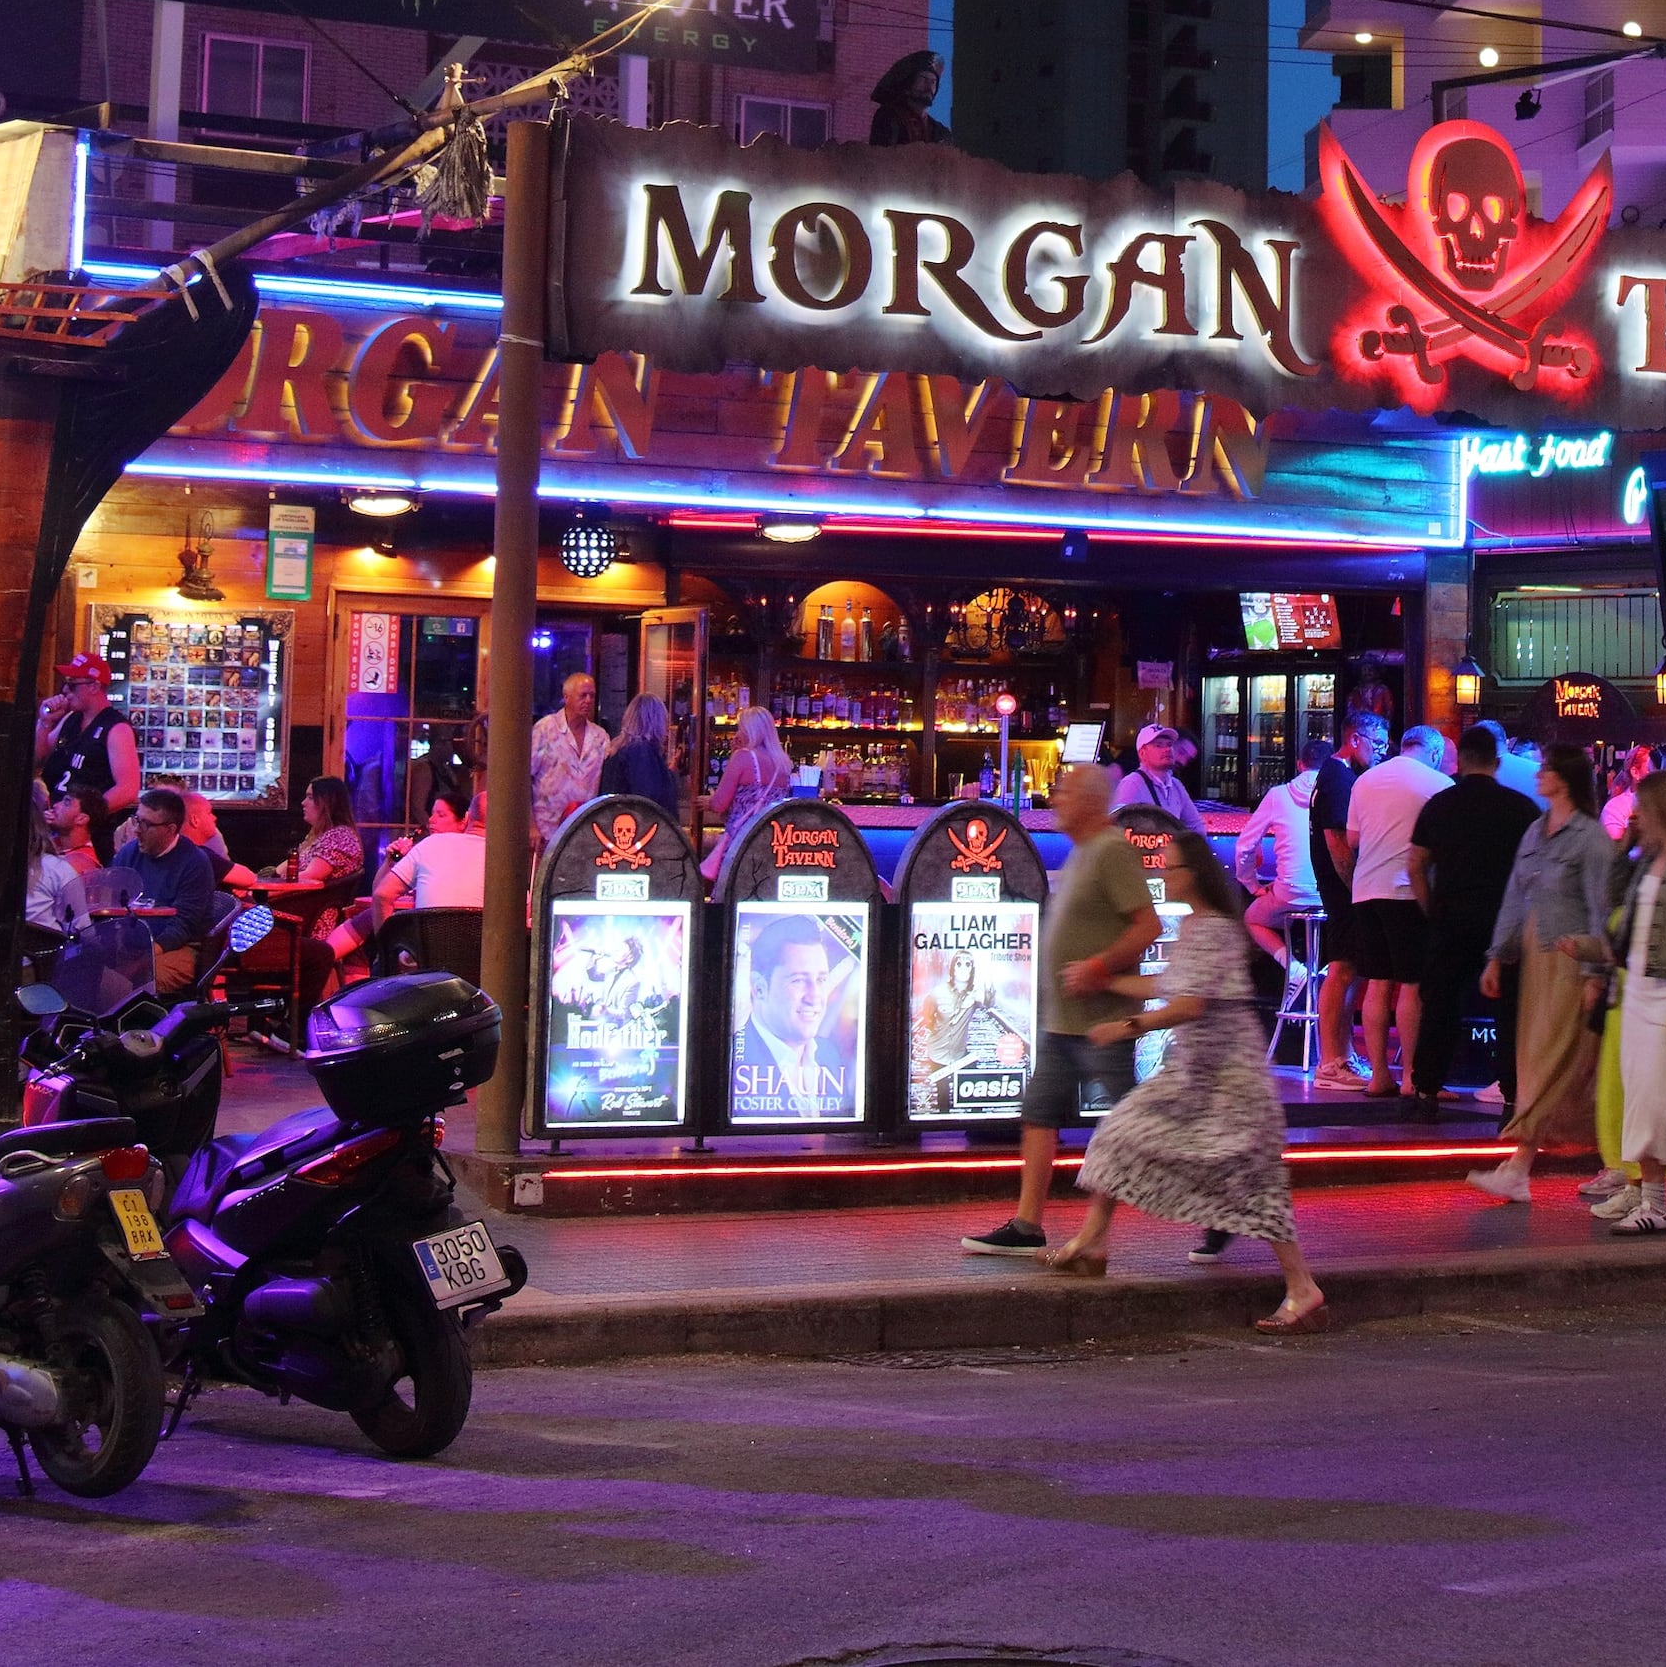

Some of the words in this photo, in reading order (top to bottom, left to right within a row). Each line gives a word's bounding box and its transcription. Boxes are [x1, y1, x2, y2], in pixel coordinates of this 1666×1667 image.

[630, 184, 1321, 376] MORGAN
[771, 820, 839, 847] MORGAN
[773, 845, 837, 868] TAVERN
[950, 915, 997, 932] LIAM
[914, 933, 1032, 950] GALLAGHER
[991, 952, 1013, 962] Tribute
[735, 1064, 846, 1096] SHAUN
[959, 1074, 1021, 1099] oasis
[601, 1092, 623, 1111] Rod
[734, 1096, 784, 1111] FOSTER
[125, 1214, 150, 1229] 198
[434, 1229, 486, 1265] 3050
[444, 1259, 488, 1290] KBG
